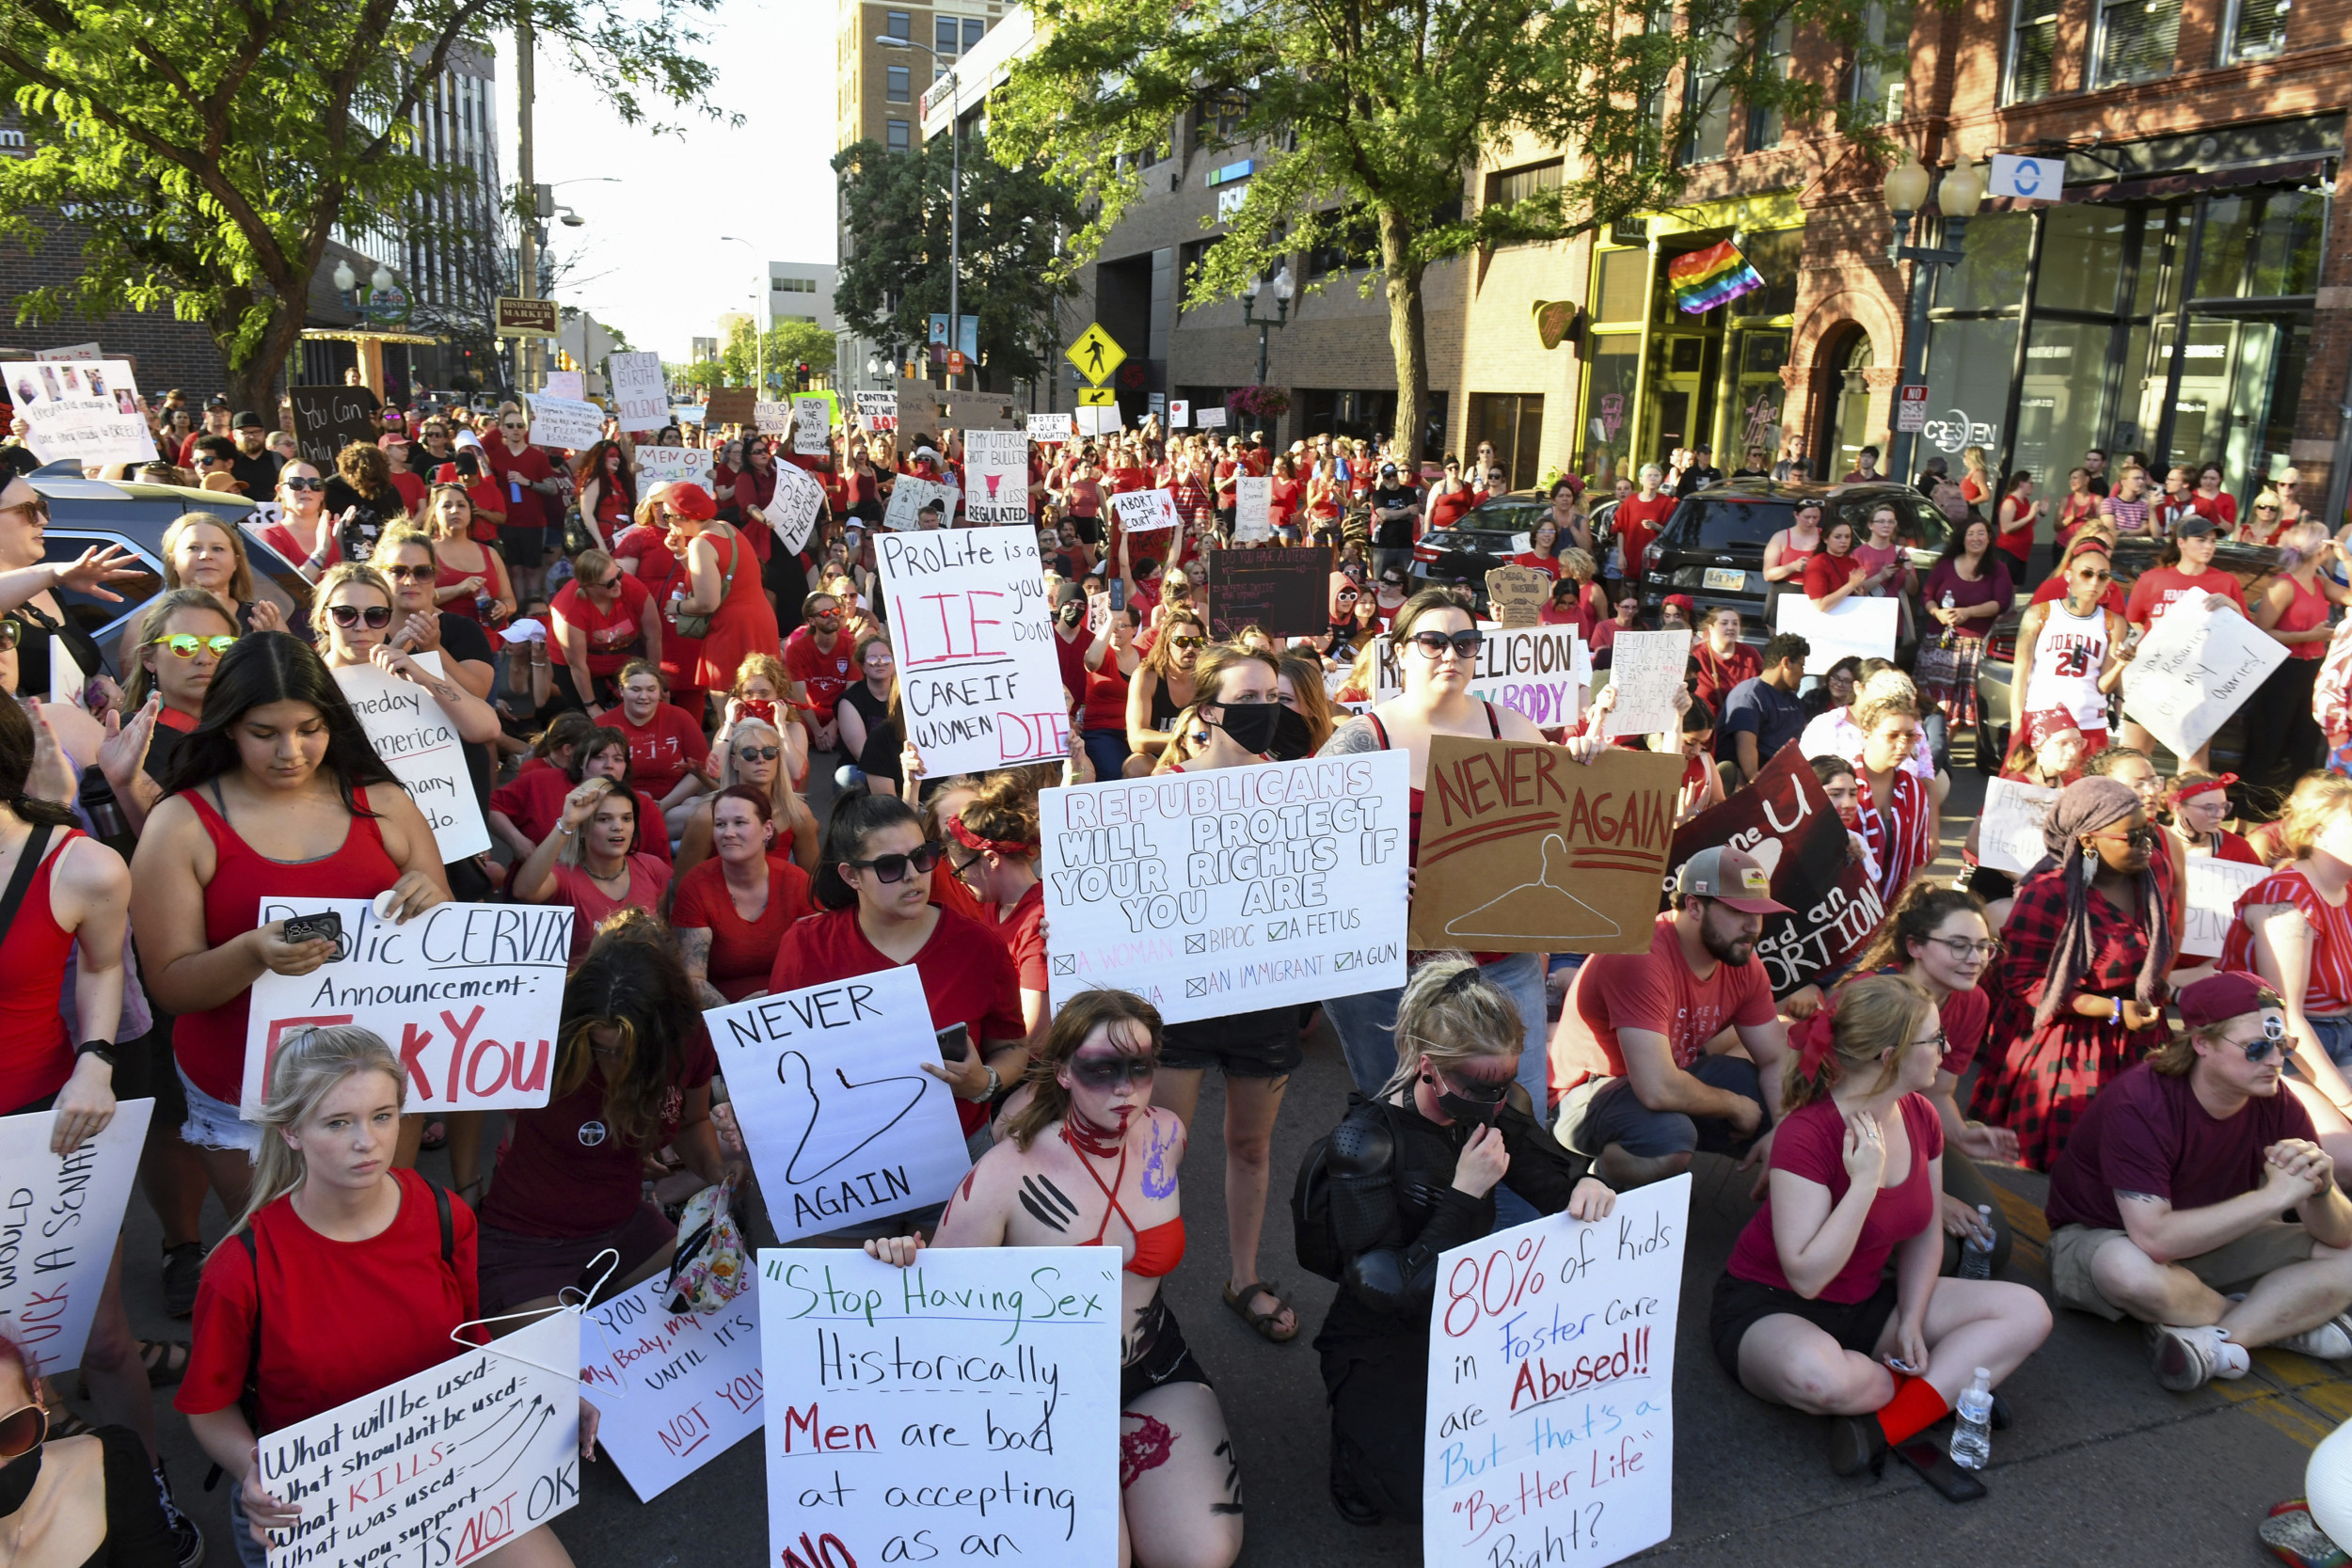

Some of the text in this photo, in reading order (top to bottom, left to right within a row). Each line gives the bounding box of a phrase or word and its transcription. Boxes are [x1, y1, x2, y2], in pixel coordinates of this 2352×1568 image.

[502, 300, 551, 310] HISTORICAL
[503, 309, 552, 319] MARKER
[610, 353, 659, 369] FORCED
[619, 370, 656, 388] BIRTH
[296, 396, 362, 432] You Can
[620, 398, 666, 420] VIOLENCE
[803, 401, 822, 409] END
[804, 411, 817, 420] THE
[1907, 388, 1923, 400] NO
[798, 420, 823, 431] WAR
[991, 433, 1026, 449] UTERUS
[638, 449, 707, 467] MEN OF
[992, 451, 1027, 465] BULLETS
[775, 468, 797, 514] USA
[791, 485, 803, 515] NOT
[969, 506, 1027, 522] REGULATED
[1004, 488, 1027, 502] LESS
[1120, 495, 1154, 512] ABORT
[1141, 509, 1157, 518] THE
[1125, 516, 1151, 529] COURT
[1026, 546, 1039, 559] a
[1240, 551, 1254, 563] YOU
[896, 591, 1008, 667] LIE
[1473, 633, 1572, 680] ELIGION
[350, 689, 421, 716] meday
[909, 673, 1019, 717] CARE IF
[1503, 680, 1567, 724] BODY
[373, 726, 454, 756] merica
[916, 711, 1071, 761] WOMEN DIE
[1618, 714, 1661, 733] CHILD
[1065, 760, 1373, 830] REPUBLICANS
[1434, 747, 1567, 827] NEVER
[1058, 796, 1383, 868] WILL PROTECT
[1567, 786, 1677, 850] AGAIN
[1051, 828, 1399, 906] YOUR RIGHTS IF
[1120, 872, 1327, 933] YOU ARE
[1807, 886, 1847, 923] an
[421, 908, 575, 964] CERVIX
[1077, 908, 1361, 974] A WOMAN BIPOC A FETUS
[1762, 879, 1885, 991] ORTION
[311, 974, 540, 1008] Announcement:
[1208, 942, 1398, 994] AN IMMIGRANT A GUN
[726, 985, 883, 1048] NEVER
[33, 1132, 98, 1275] A SENAT
[794, 1165, 911, 1227] AGAIN
[766, 1259, 1115, 1346] "Stop Having Sex"
[1444, 1235, 1546, 1338] 80%
[1560, 1227, 1596, 1284] of
[593, 1294, 647, 1335] YOU
[644, 1315, 754, 1390] UNTIL IT'S
[1454, 1355, 1477, 1385] in
[1499, 1303, 1596, 1364] Foster
[818, 1327, 1059, 1418] Historically
[1439, 1324, 1651, 1439] are Abused!!
[264, 1422, 343, 1481] What
[352, 1394, 395, 1440] will
[401, 1389, 430, 1418] be
[658, 1401, 710, 1457] NOT
[785, 1400, 1054, 1456] Men are bad
[1439, 1399, 1662, 1489] But that's a
[268, 1464, 339, 1505] What
[444, 1406, 467, 1431] be
[354, 1486, 483, 1568] you support
[455, 1491, 518, 1560] NOT
[527, 1461, 580, 1522] OK
[798, 1470, 1075, 1543] at accepting
[270, 1528, 343, 1568] What
[346, 1503, 398, 1540] was
[882, 1529, 939, 1563] as
[961, 1533, 1022, 1559] an
